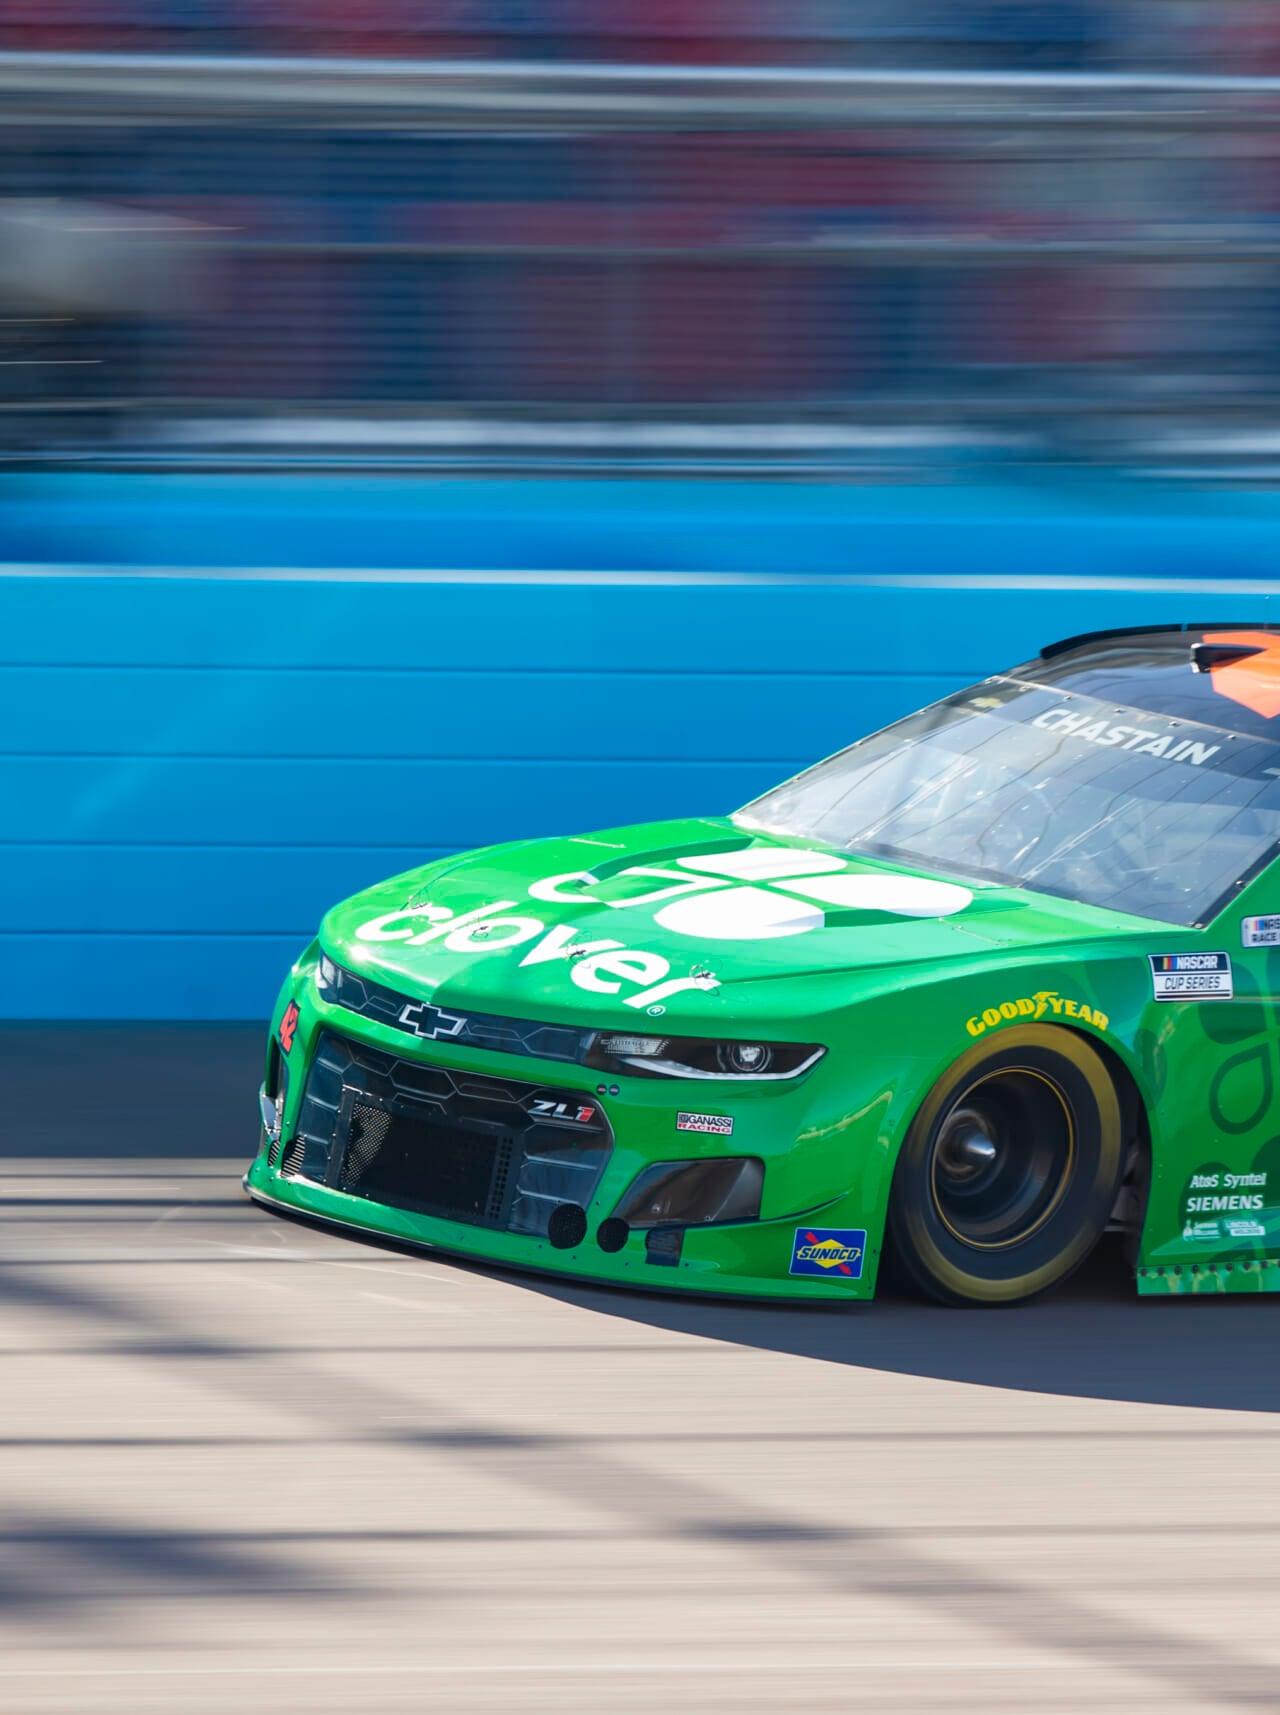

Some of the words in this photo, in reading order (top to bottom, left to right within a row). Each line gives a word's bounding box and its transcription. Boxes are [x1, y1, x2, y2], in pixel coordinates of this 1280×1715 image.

[1031, 709, 1221, 765] CHASTAIN
[1252, 933, 1277, 943] RACE
[354, 900, 722, 1009] clover
[1177, 956, 1218, 970] NASCAR
[1165, 977, 1185, 990] CUP
[1186, 976, 1221, 989] SERIES
[966, 991, 1109, 1036] GOODYEAR
[280, 1002, 299, 1052] 42
[527, 1099, 596, 1123] ZL1
[678, 1123, 731, 1133] RACING
[688, 1114, 732, 1127] GANASSI
[1186, 1194, 1263, 1212] SIEMENS
[800, 1247, 858, 1260] SUNOCO
